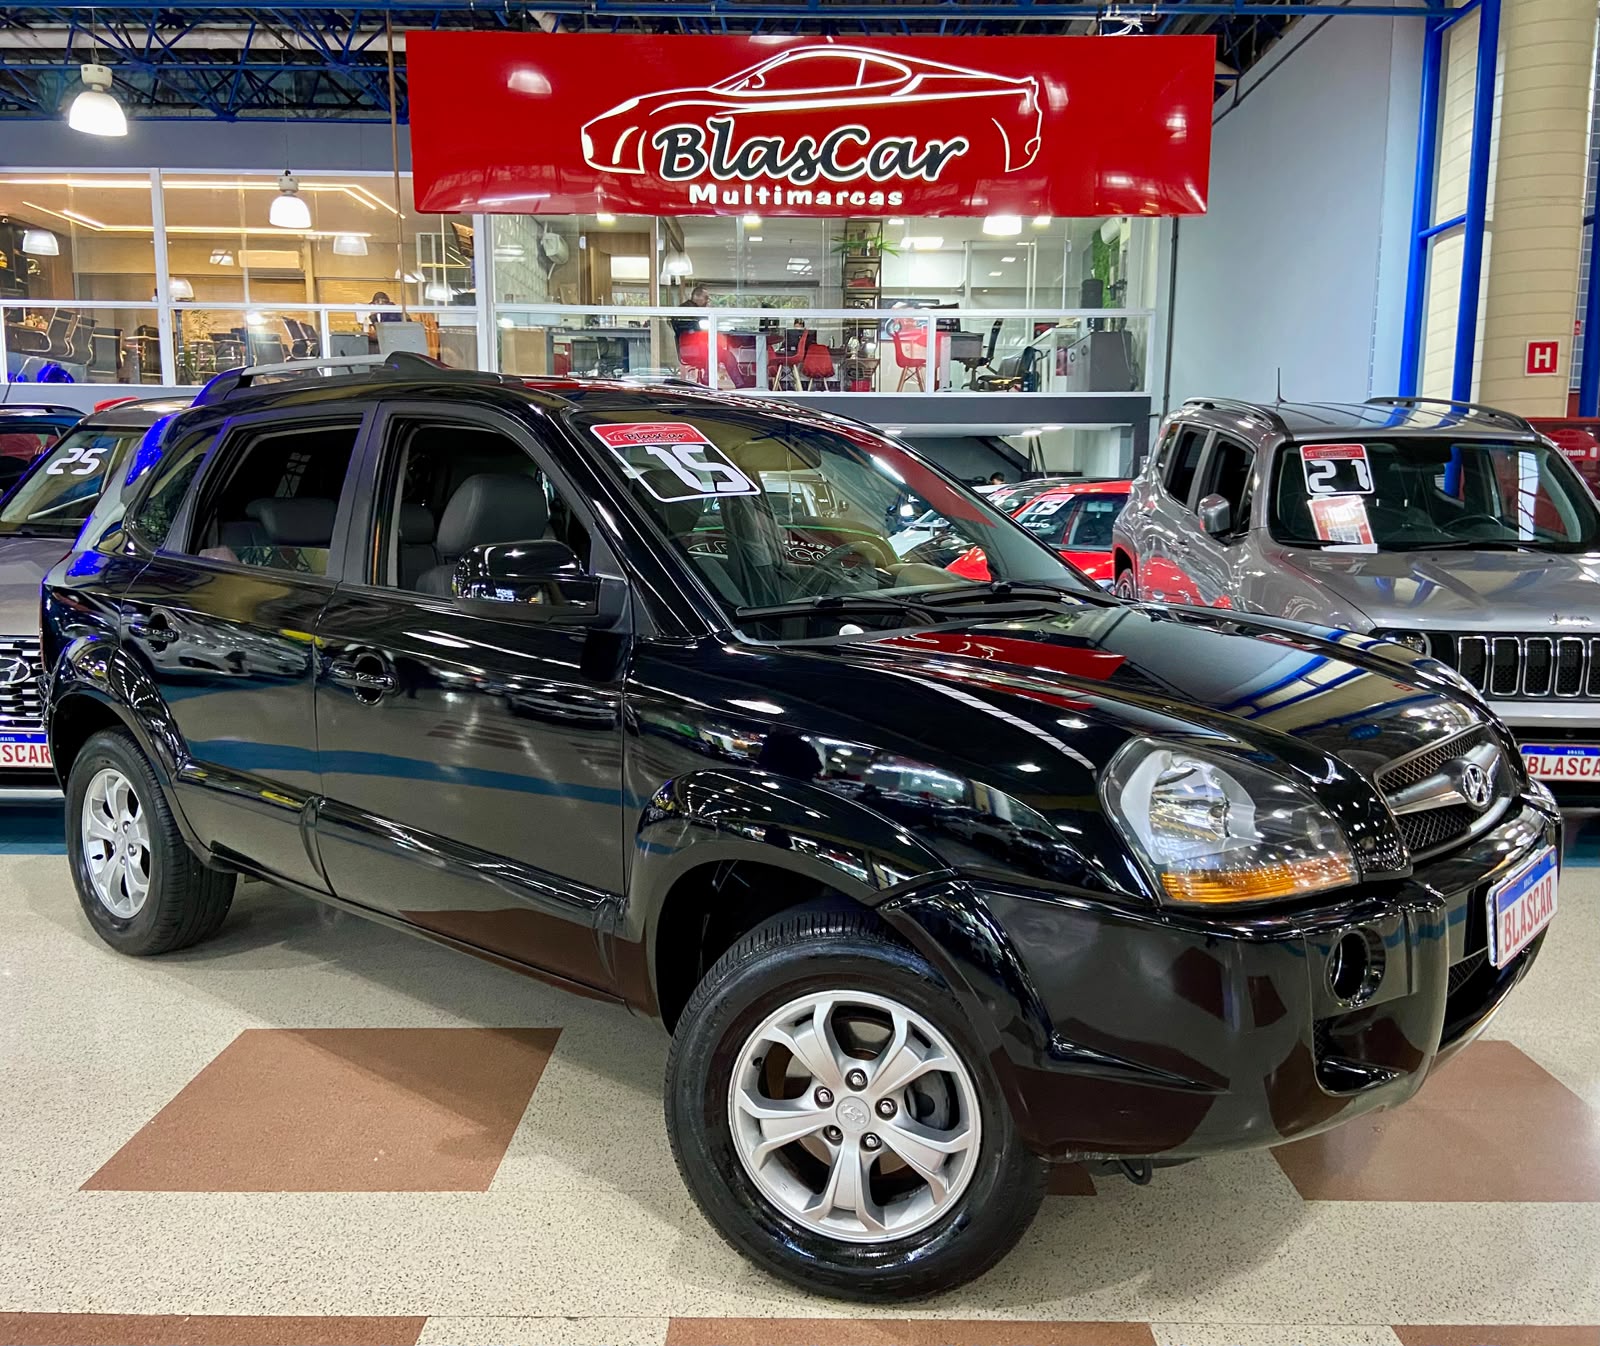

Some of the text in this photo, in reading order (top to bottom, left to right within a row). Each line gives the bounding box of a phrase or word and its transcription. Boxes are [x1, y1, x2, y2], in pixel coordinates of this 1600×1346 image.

[653, 117, 969, 184] BlasCar
[688, 183, 904, 207] Multimarcas
[1534, 347, 1552, 369] H
[46, 447, 108, 476] 25
[1308, 459, 1371, 493] 21
[1504, 876, 1553, 952] BLASCAR
